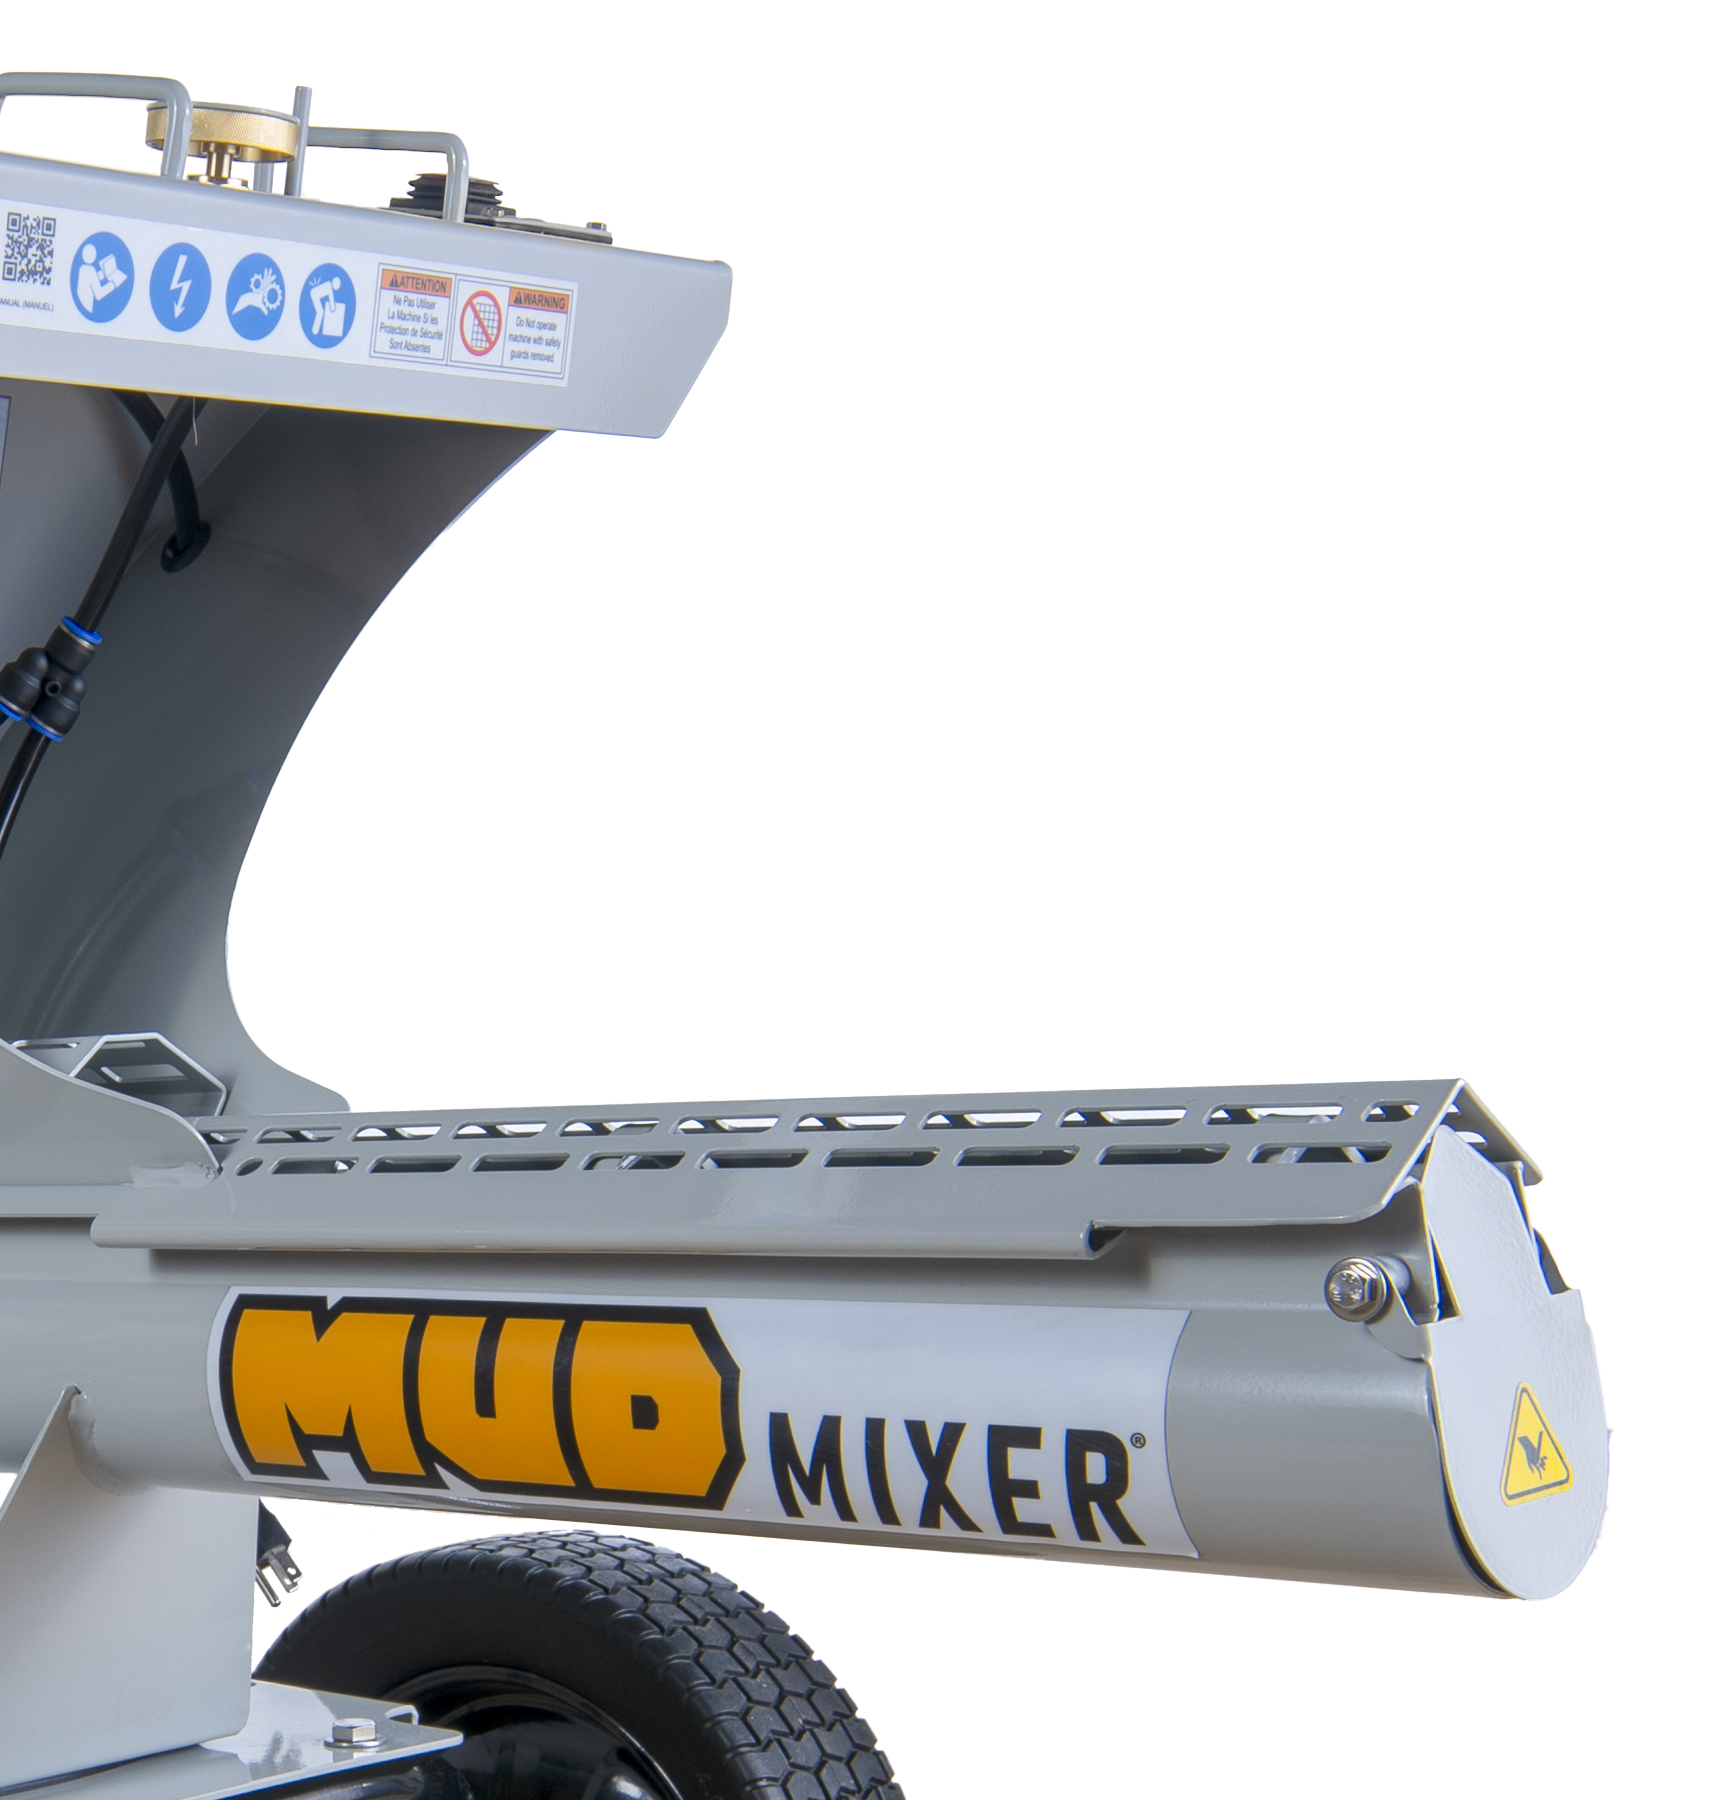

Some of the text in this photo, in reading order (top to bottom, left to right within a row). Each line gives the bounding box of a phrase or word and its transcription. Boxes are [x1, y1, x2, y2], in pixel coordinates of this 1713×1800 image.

[397, 275, 447, 294] ATTENTION
[22, 299, 54, 312] (MANUEL)
[393, 294, 437, 310] Ne Pas Utiliser
[523, 293, 566, 310] WARNING
[388, 308, 396, 319] La
[397, 308, 421, 323] Machine
[422, 313, 429, 324] Si
[516, 316, 557, 333] Do Not operate
[380, 321, 409, 336] Protection
[410, 326, 418, 338] de
[389, 338, 431, 354] Sont Absentes
[508, 332, 562, 350] machine with safety
[510, 349, 555, 363] guards removed.
[219, 1293, 747, 1512] MUD
